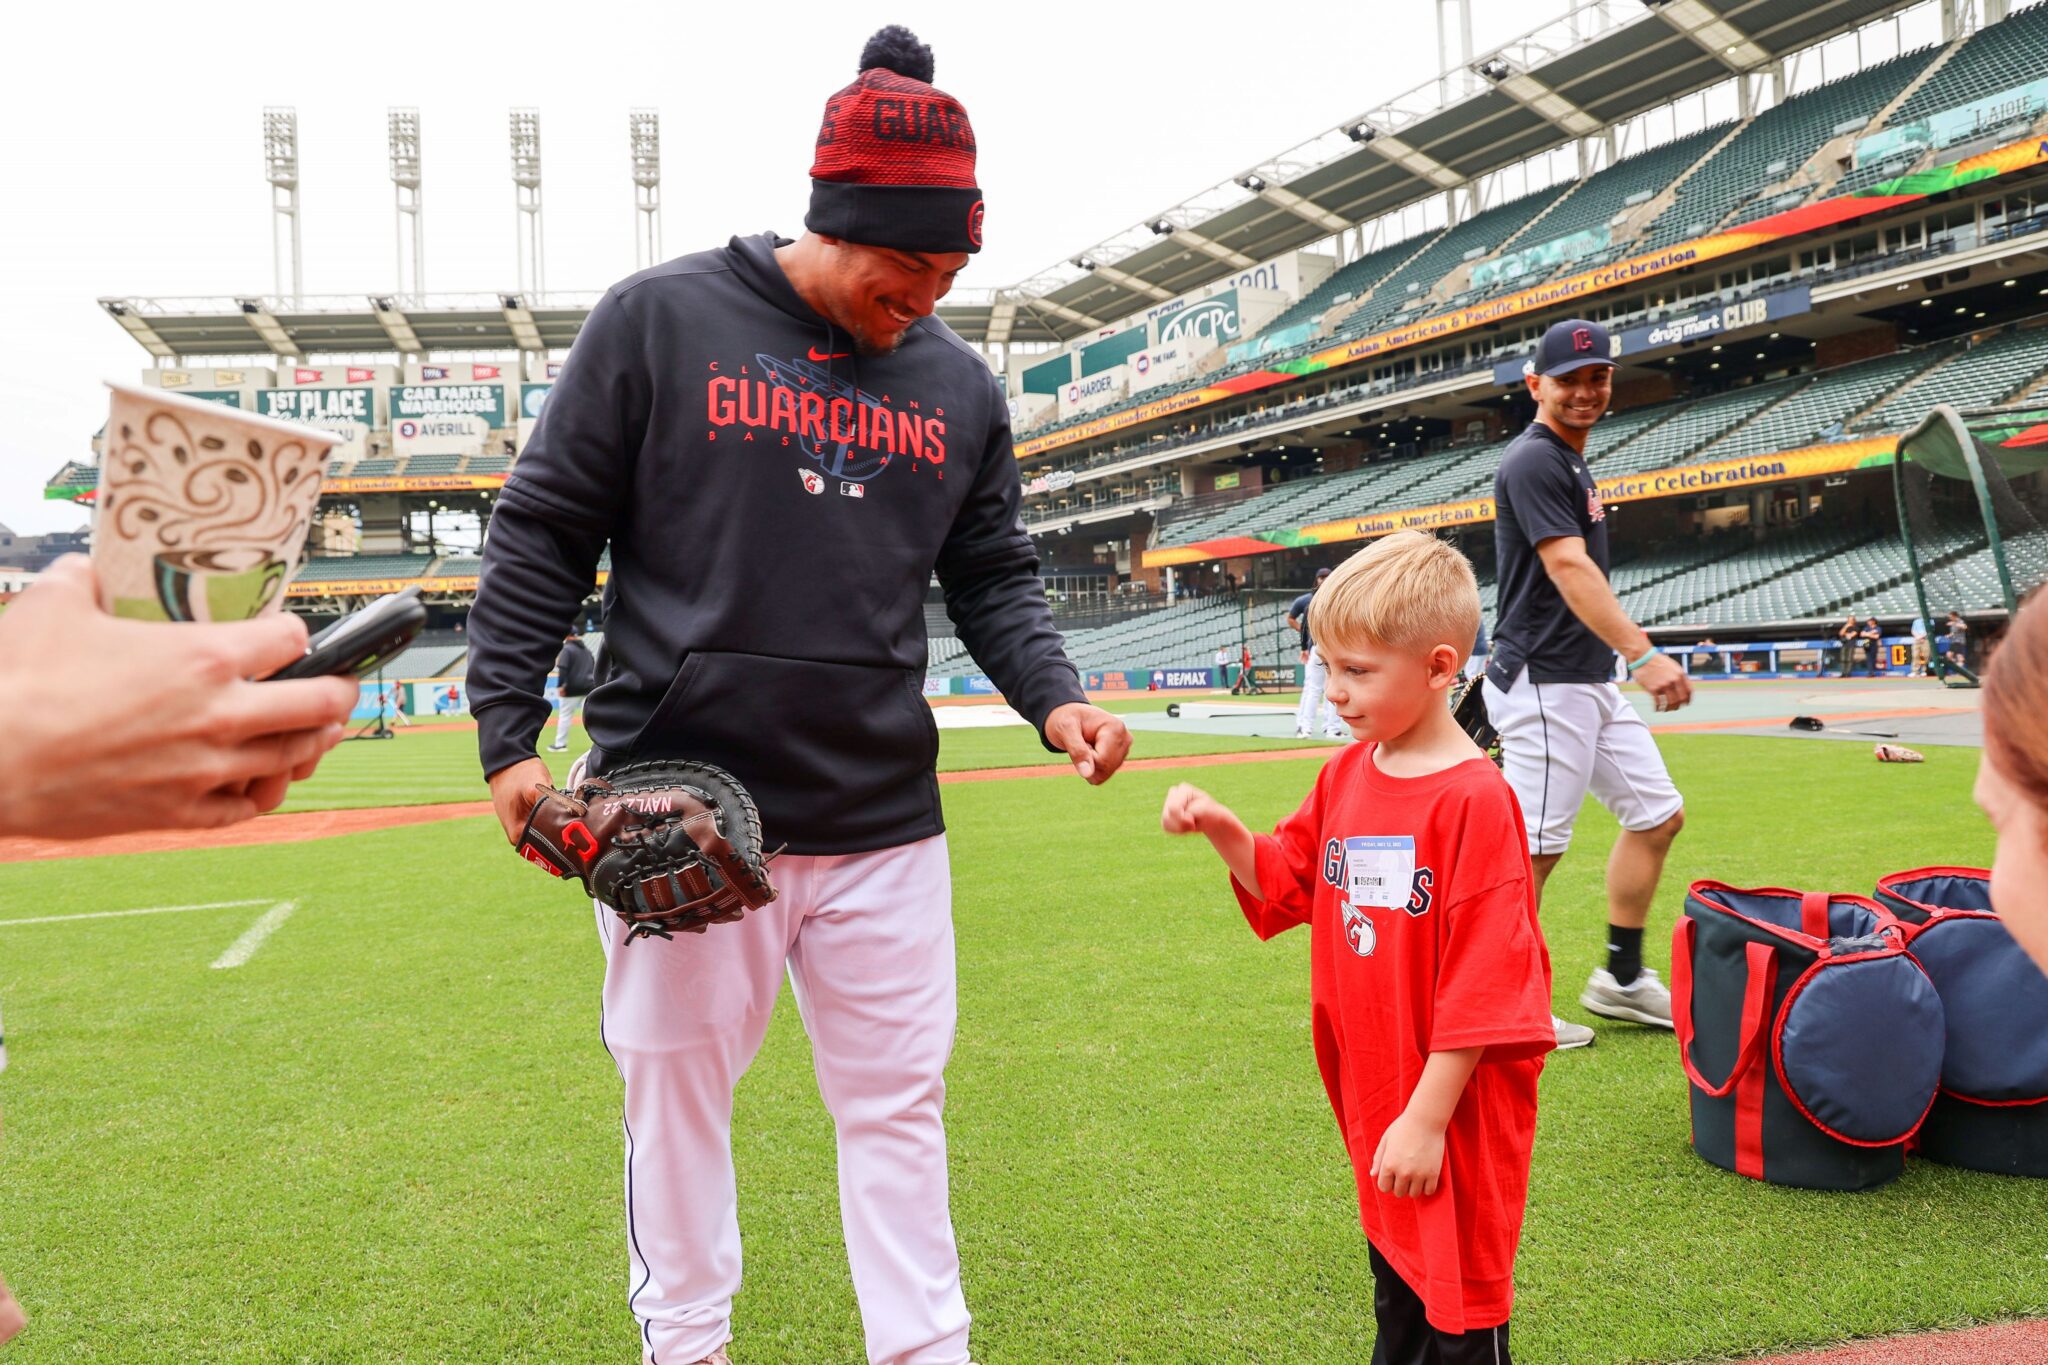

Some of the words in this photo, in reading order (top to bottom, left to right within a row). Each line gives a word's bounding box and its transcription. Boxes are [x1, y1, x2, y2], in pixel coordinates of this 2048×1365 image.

[1346, 342, 1380, 358] Asian
[1385, 322, 1447, 347] American
[1451, 316, 1460, 328] &
[1465, 299, 1514, 325] Pacific
[1520, 278, 1589, 309] Islander
[1593, 249, 1697, 287] Celebration
[1648, 327, 1682, 344] drug
[1683, 314, 1720, 336] mart
[1723, 299, 1767, 330] CLUB
[402, 387, 436, 401] CAR
[439, 386, 492, 400] PARTS
[1080, 376, 1112, 398] HARDER
[300, 390, 367, 417] PLACE
[398, 398, 497, 415] WAREHOUSE
[419, 423, 476, 437] AVERILL
[707, 375, 946, 465] GUARDIANS
[1355, 519, 1394, 535] Asian
[1400, 507, 1474, 529] American
[1601, 478, 1647, 500] nder
[1655, 459, 1786, 492] Celebration
[1166, 671, 1207, 686] RE/MAX
